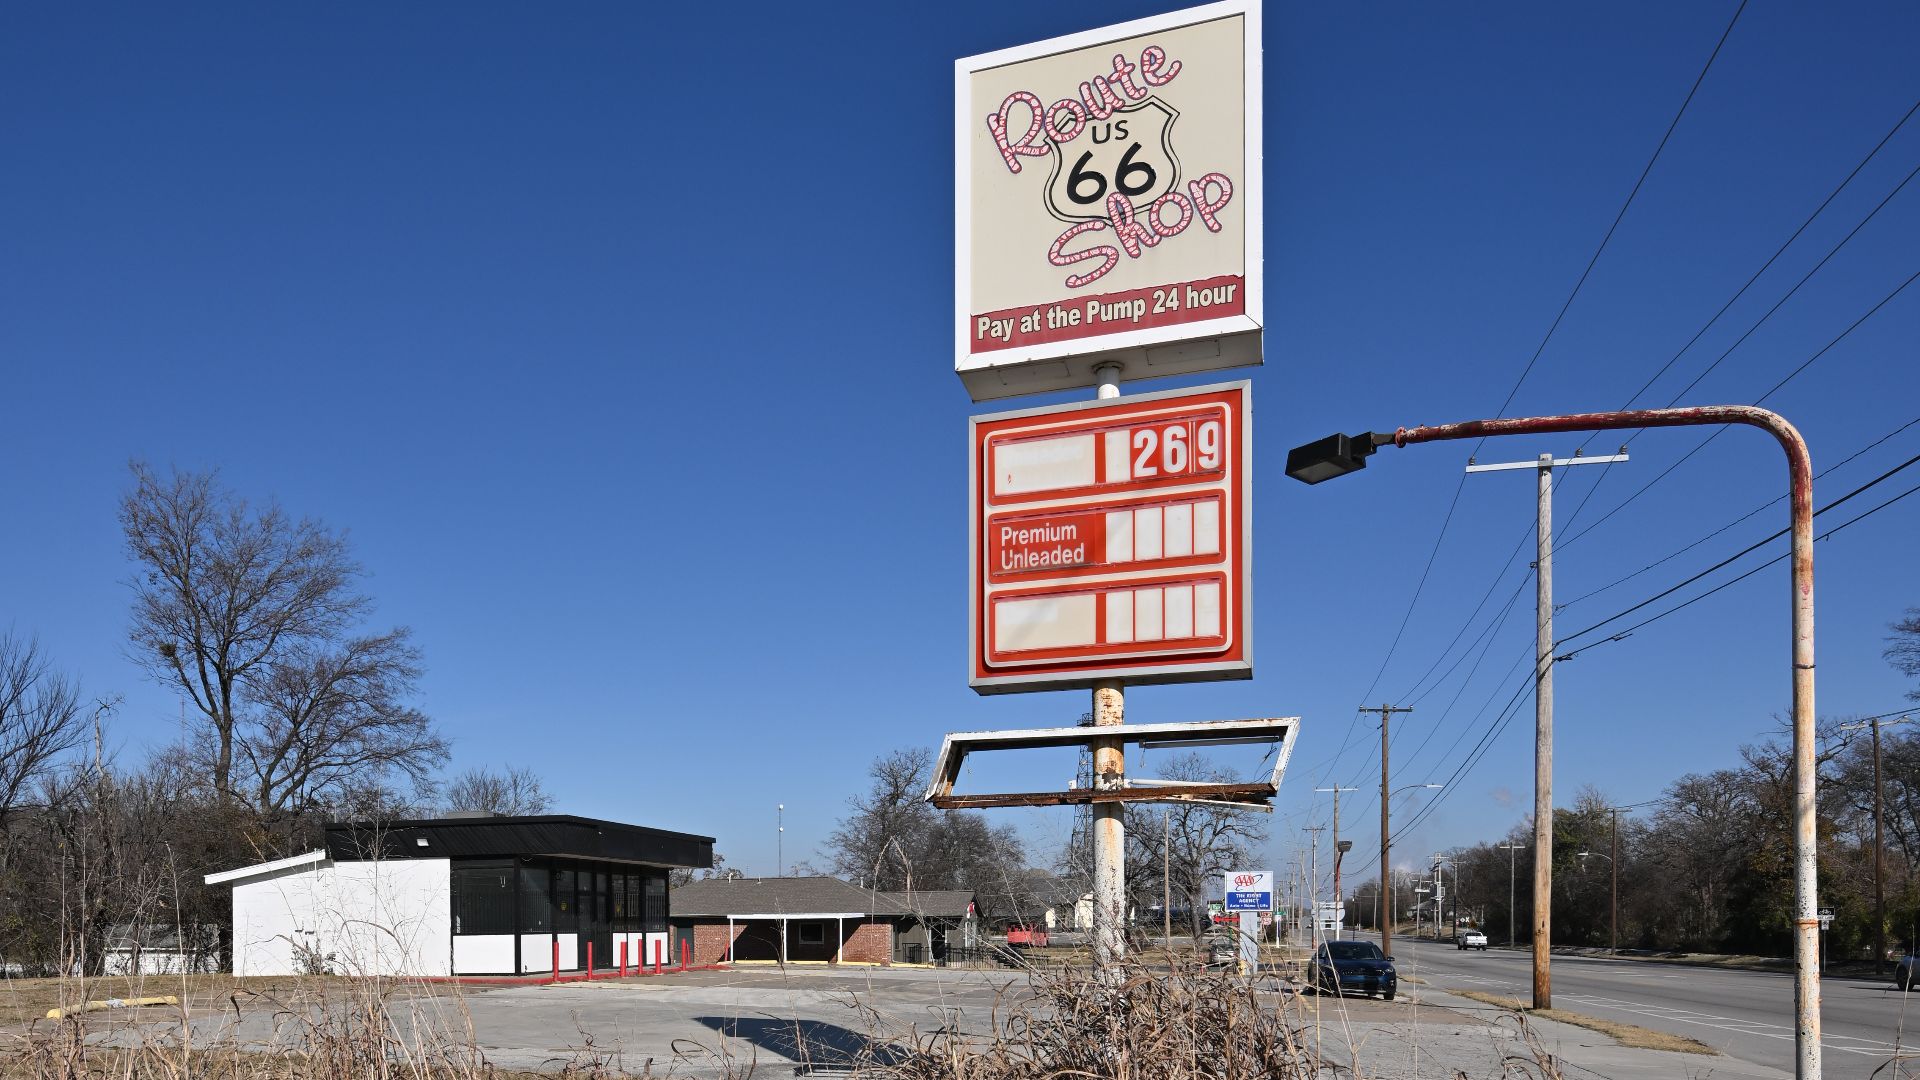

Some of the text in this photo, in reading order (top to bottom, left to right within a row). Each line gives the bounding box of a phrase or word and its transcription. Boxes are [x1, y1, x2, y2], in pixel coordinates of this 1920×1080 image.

[986, 45, 1182, 174] Route
[1091, 120, 1129, 144] US
[1066, 142, 1157, 204] 66
[1048, 173, 1233, 288] Shop
[977, 283, 1237, 342] Pay at the Pump 24 hour
[1001, 522, 1077, 547] Premium
[1001, 543, 1085, 571] Unleaded
[1235, 875, 1254, 886] AAA
